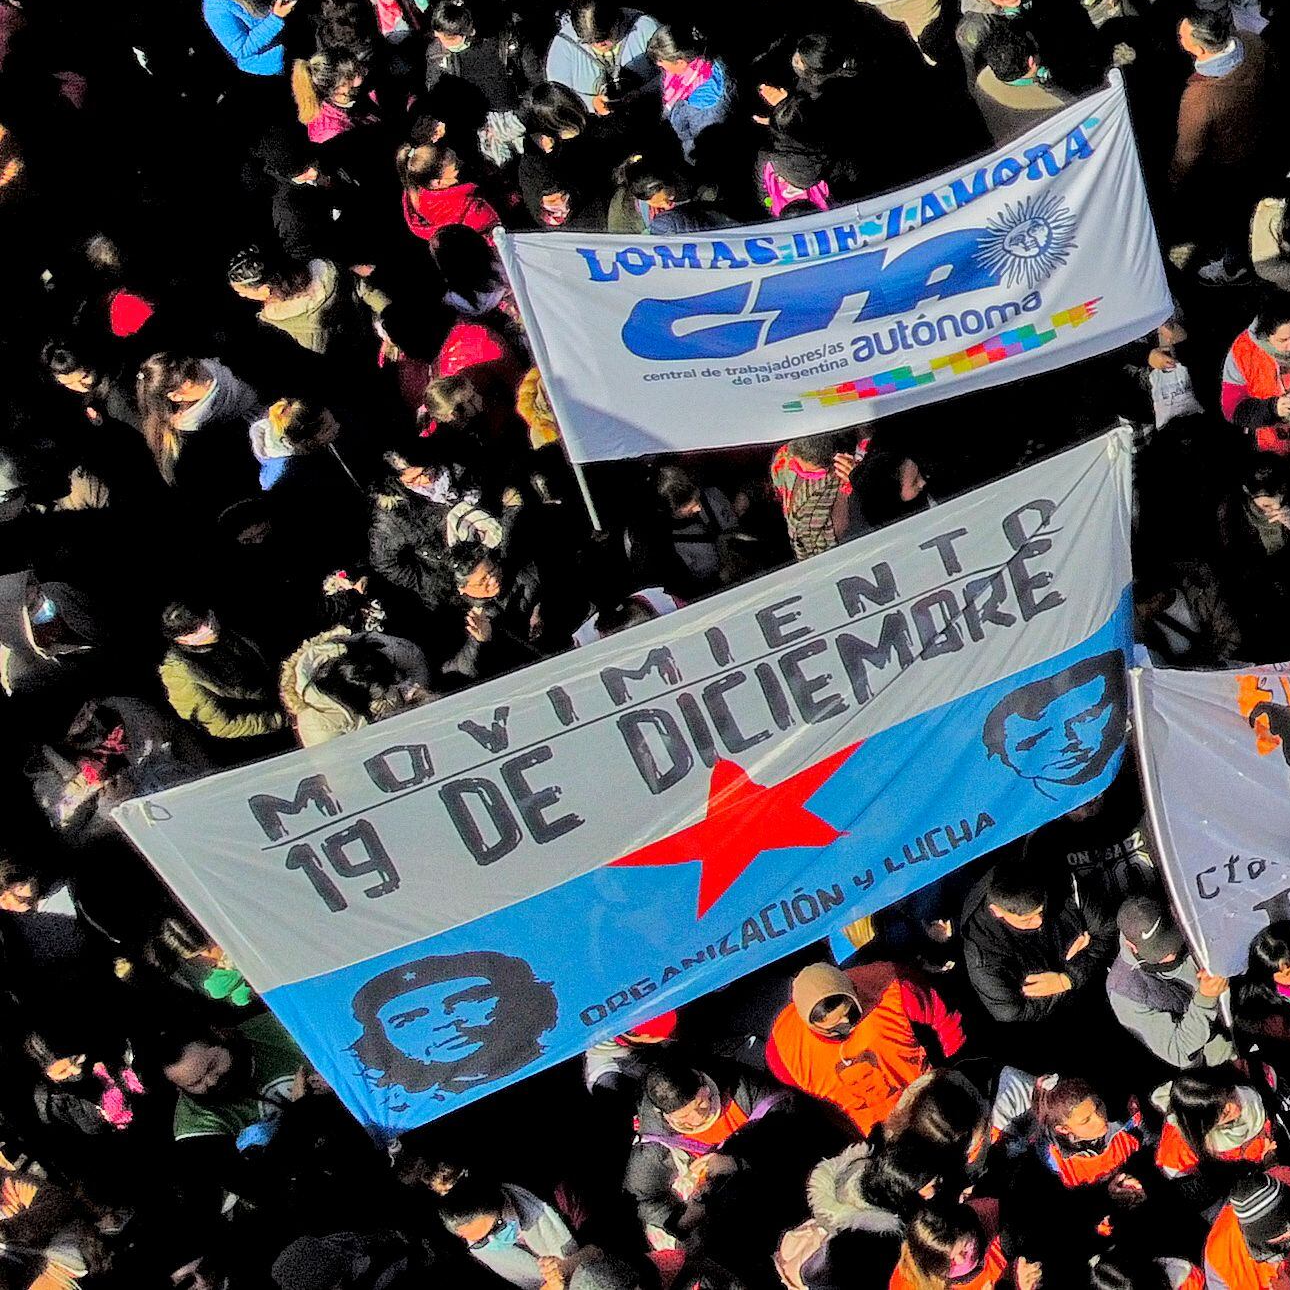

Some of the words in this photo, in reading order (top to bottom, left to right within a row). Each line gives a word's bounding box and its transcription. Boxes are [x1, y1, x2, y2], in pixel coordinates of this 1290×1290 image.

[576, 236, 780, 282] LOMAS
[851, 288, 1043, 365] autónoma
[643, 368, 696, 382] central
[701, 367, 721, 378] de
[726, 340, 844, 377] trabajadores/as
[732, 374, 752, 386] de
[756, 372, 771, 383] la
[775, 356, 848, 382] argentina
[284, 818, 400, 913] 19
[439, 745, 584, 867] DE
[580, 883, 845, 1027] ORGANIZACIÓN
[884, 812, 996, 874] LUCHA
